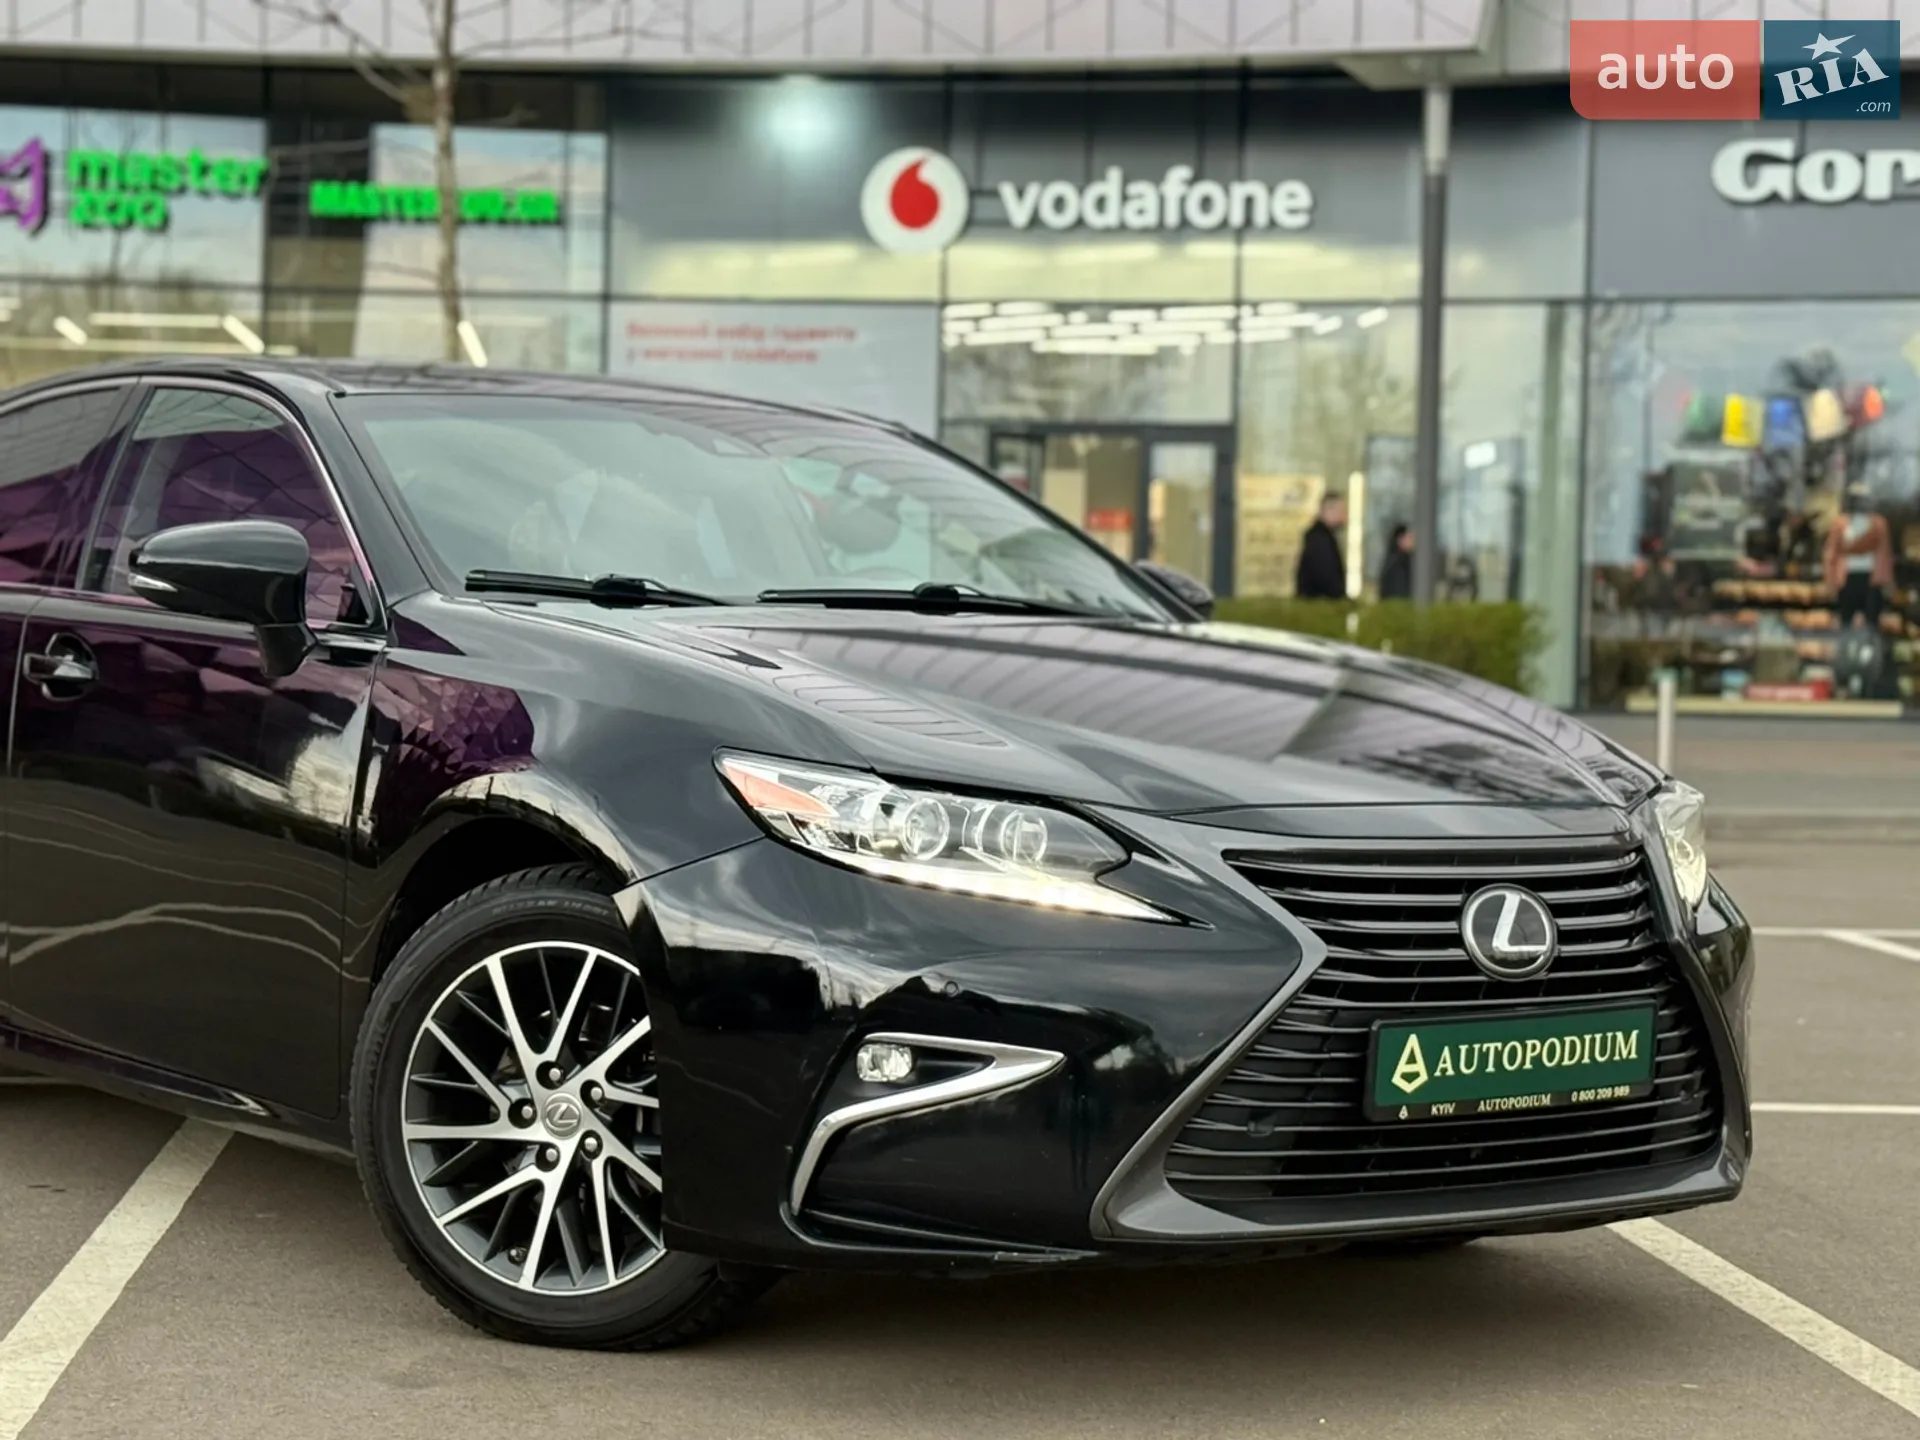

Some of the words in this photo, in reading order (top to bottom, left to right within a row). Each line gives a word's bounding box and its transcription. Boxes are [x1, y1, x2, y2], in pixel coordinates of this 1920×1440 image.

[67, 148, 270, 195] master
[997, 164, 1313, 230] vodafone
[1433, 1029, 1640, 1078] AUTOPODIUM
[1430, 1102, 1456, 1117] KYIV
[1477, 1093, 1552, 1113] AUTOPODIUM
